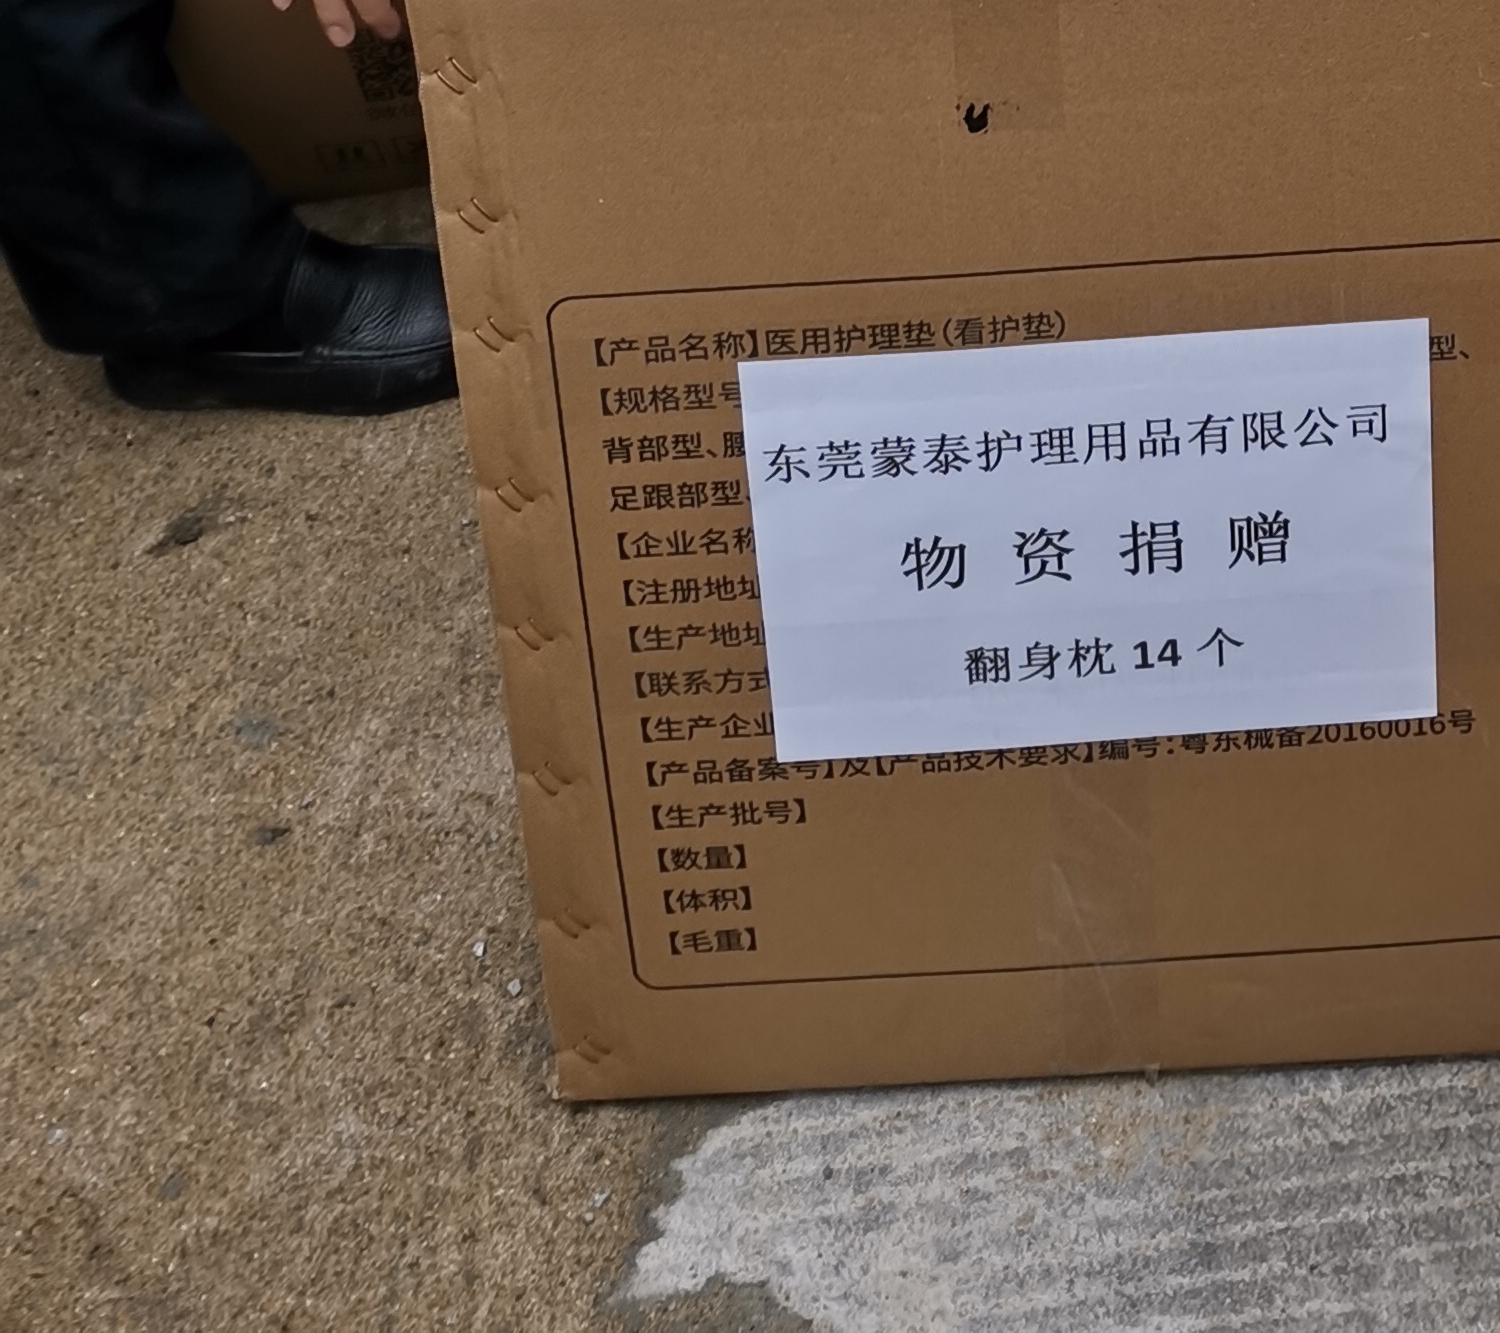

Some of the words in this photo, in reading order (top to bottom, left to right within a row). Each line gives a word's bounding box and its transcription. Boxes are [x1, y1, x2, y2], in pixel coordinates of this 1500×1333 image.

[762, 402, 1390, 484] 东莞蒙泰护理用品有限公司
[901, 510, 1292, 593] 物资捐赠
[651, 797, 807, 831] 【生产批号】
[657, 844, 747, 873] 【数量】
[663, 886, 752, 915] 【体积】
[669, 927, 757, 955] 【毛重】
